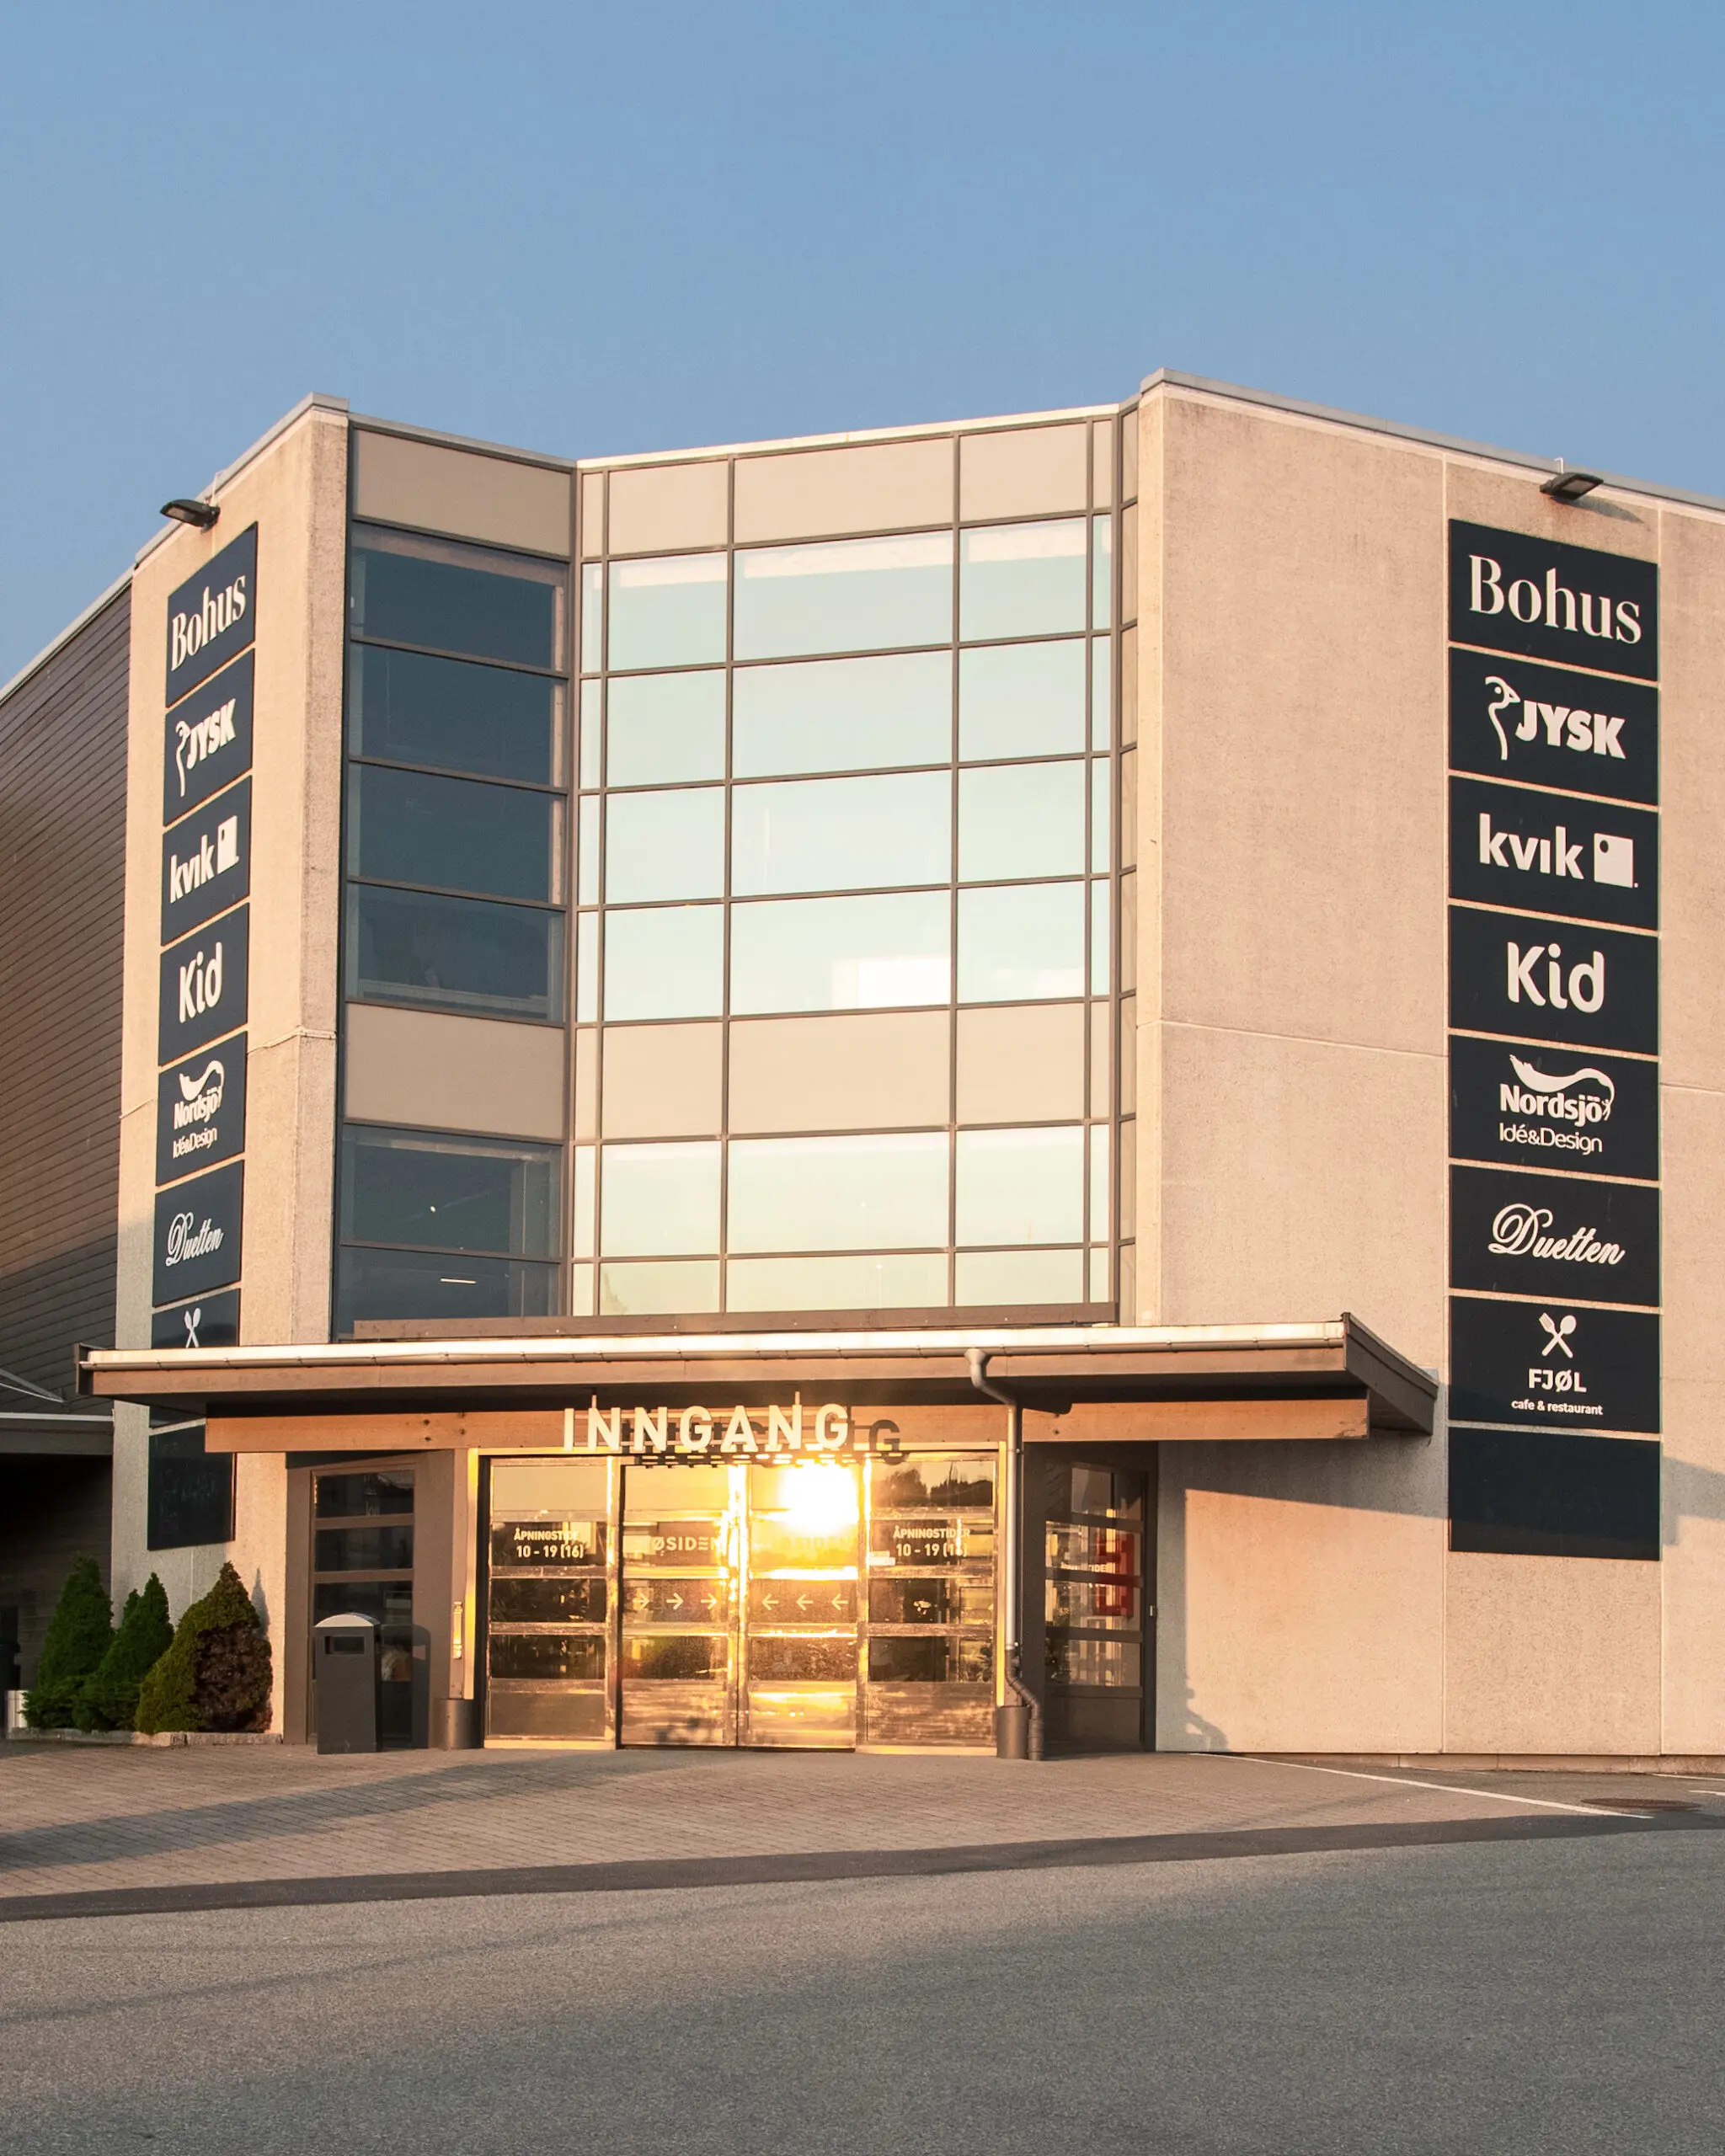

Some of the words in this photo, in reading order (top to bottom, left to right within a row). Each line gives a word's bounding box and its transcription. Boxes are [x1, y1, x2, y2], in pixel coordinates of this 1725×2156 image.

[170, 574, 247, 672] Bohus
[1468, 554, 1642, 645] Bohus
[186, 697, 236, 770] JYSK
[1515, 699, 1626, 760] JYSK
[170, 834, 216, 904] kvik
[1479, 813, 1584, 880] kvik
[179, 942, 223, 1024] Kid
[1507, 942, 1605, 1013] Kid
[174, 1086, 219, 1130] Nordsjö
[1499, 1083, 1603, 1128] Nordsjö
[1499, 1122, 1603, 1155] Idé&Design
[165, 1211, 225, 1267] Duetten
[1487, 1203, 1626, 1265] Duetten
[1511, 1398, 1535, 1411] cafe
[1536, 1400, 1546, 1412] &
[1546, 1402, 1604, 1416] restaurant
[1528, 1368, 1587, 1393] FJØL
[563, 1403, 848, 1453] INNGANG
[516, 1545, 531, 1558] 10
[543, 1545, 558, 1558] 19
[560, 1544, 584, 1559] (16)
[896, 1543, 911, 1557] 10
[924, 1543, 940, 1557] 19
